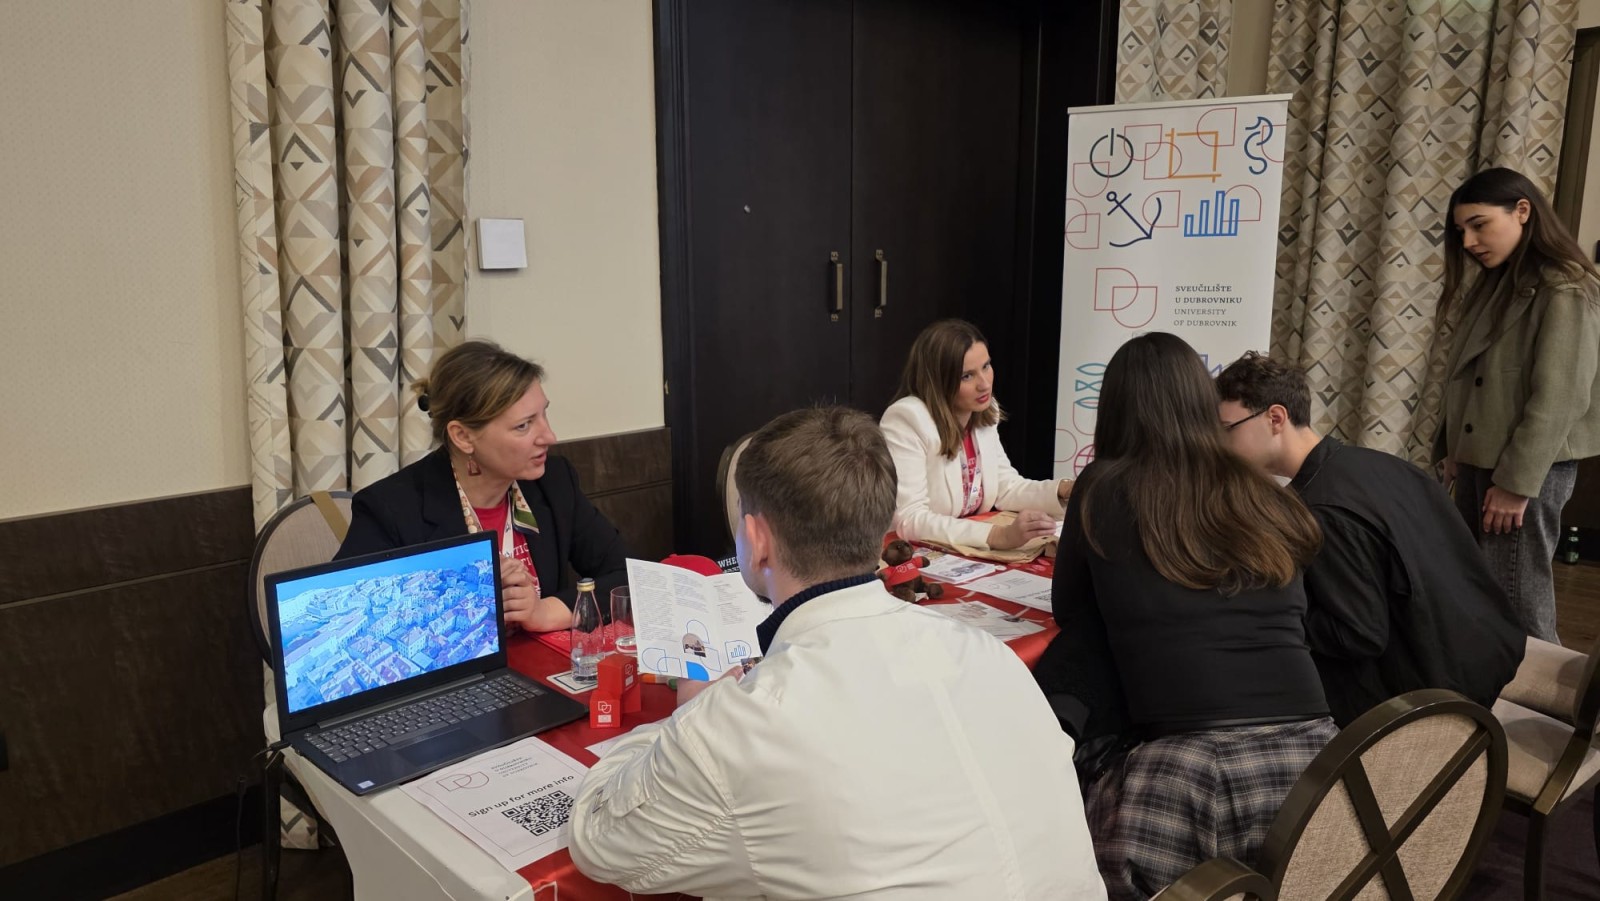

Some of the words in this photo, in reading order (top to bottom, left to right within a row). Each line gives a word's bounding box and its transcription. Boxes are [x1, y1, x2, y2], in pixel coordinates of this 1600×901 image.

[1175, 283, 1232, 292] SVEUČILIŠTE
[1175, 296, 1181, 304] U
[1183, 296, 1242, 304] DUBROVNIKU
[1173, 319, 1184, 327] OF
[1186, 319, 1238, 327] DUBROVNIK
[468, 805, 493, 818] Sign
[494, 799, 509, 808] up
[509, 793, 526, 803] for
[527, 782, 554, 797] more
[554, 774, 575, 786] info
